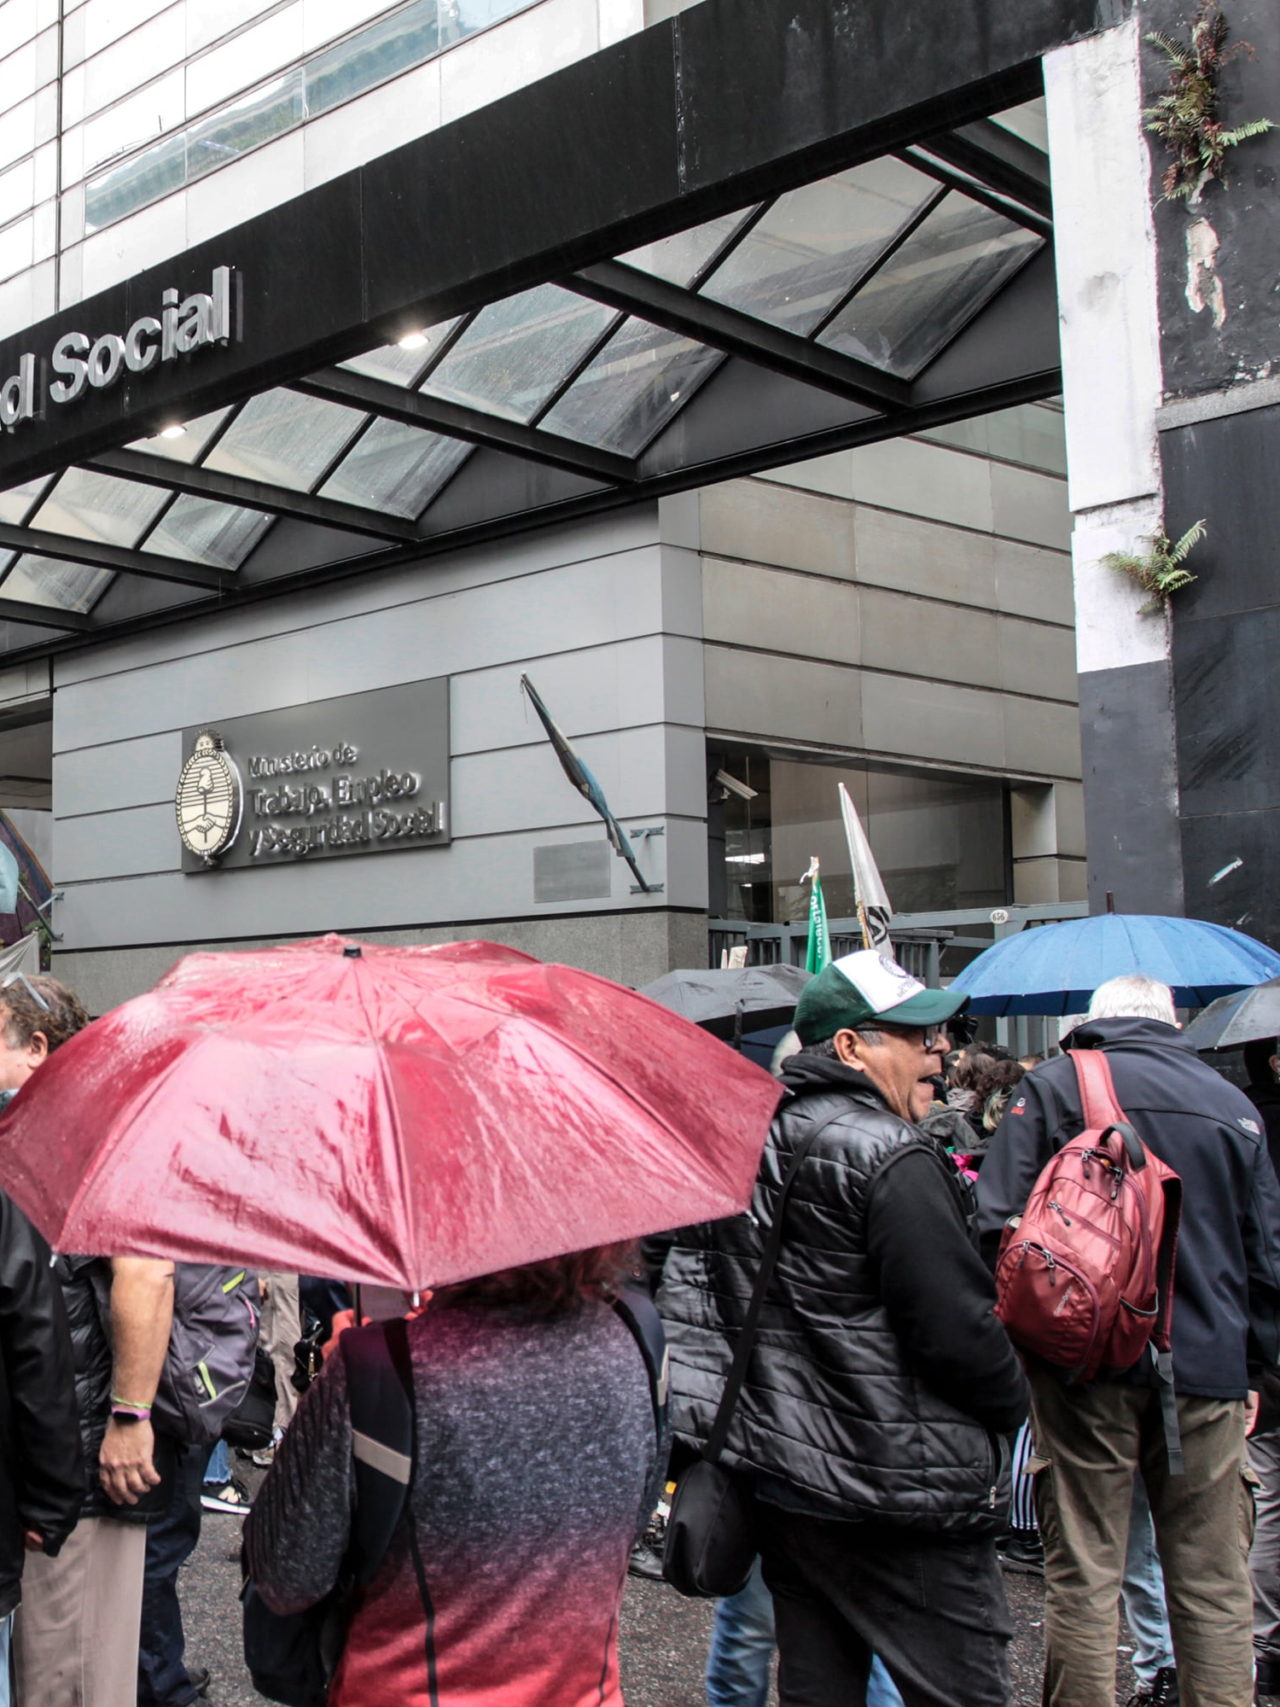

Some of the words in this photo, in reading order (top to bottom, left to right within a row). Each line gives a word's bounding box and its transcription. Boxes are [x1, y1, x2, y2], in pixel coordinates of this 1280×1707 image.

[49, 266, 230, 403] Social
[247, 745, 329, 778] Ministerio
[333, 741, 359, 764] de
[332, 768, 420, 806] Empleo
[249, 829, 263, 856] y
[263, 811, 372, 854] Seguridad
[373, 801, 444, 839] Social
